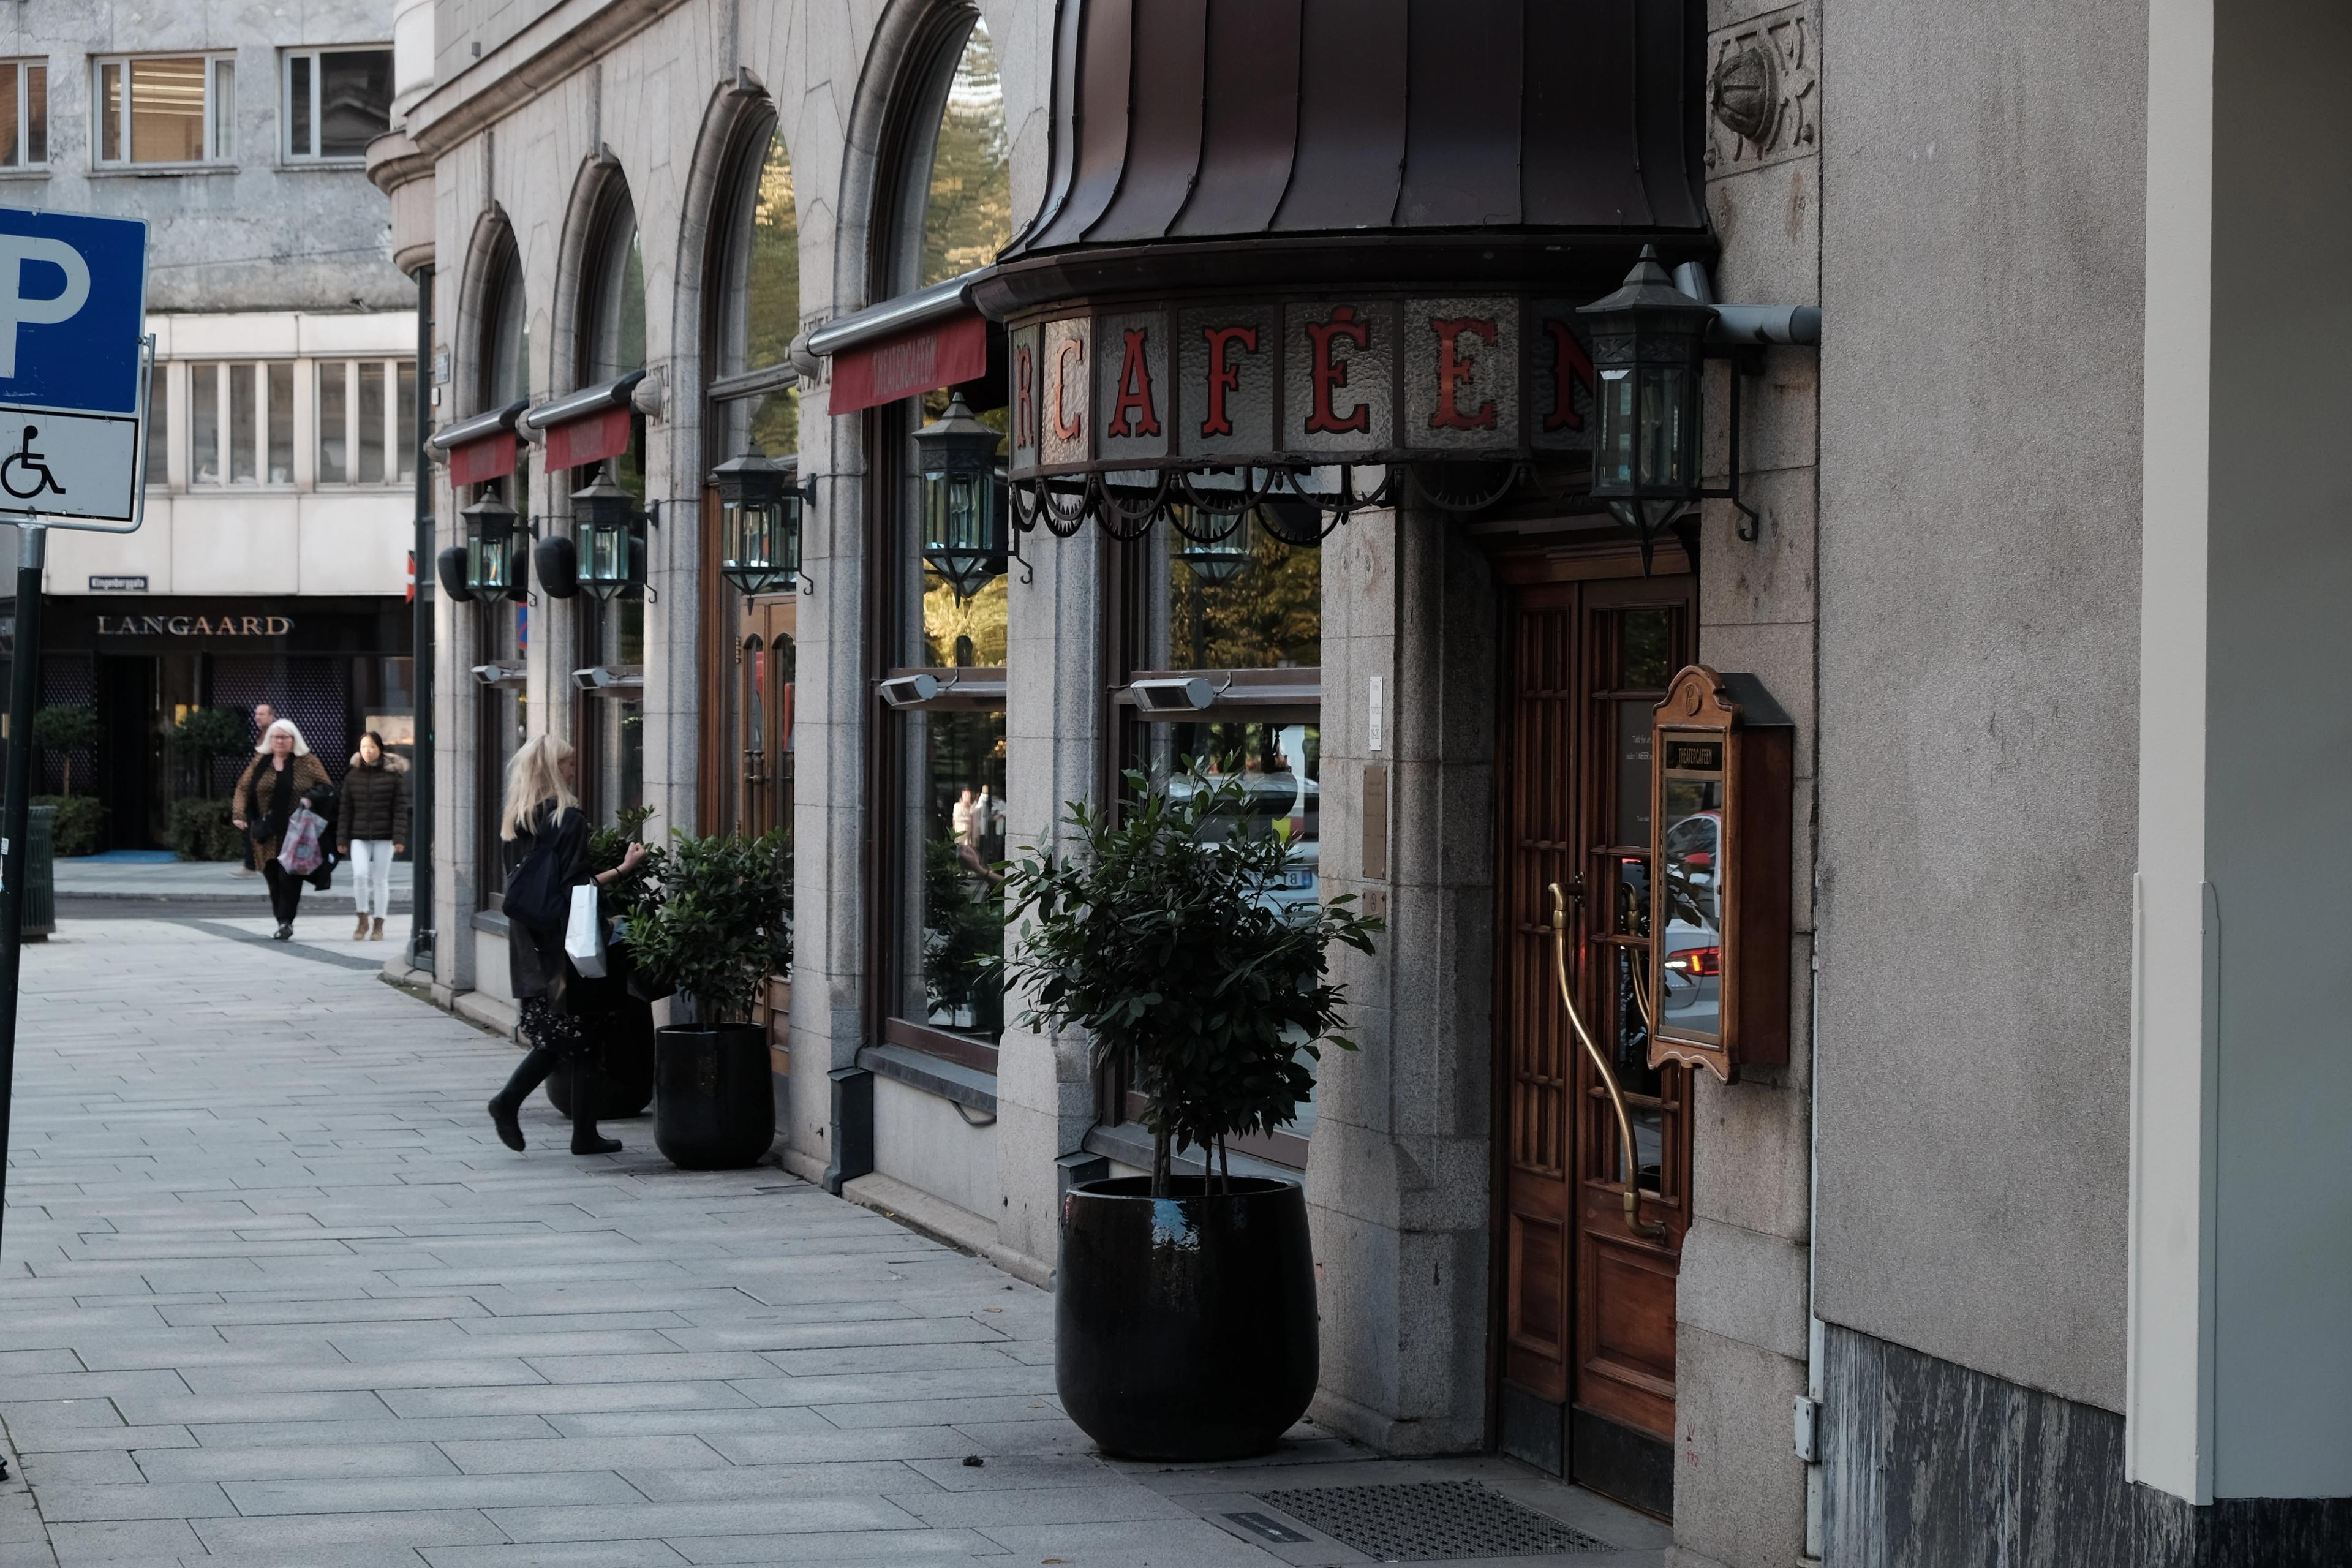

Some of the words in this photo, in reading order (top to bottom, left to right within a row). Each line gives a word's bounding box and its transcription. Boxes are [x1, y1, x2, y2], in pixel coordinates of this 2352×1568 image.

[0, 234, 91, 379] P
[96, 615, 291, 636] LANGAARD
[1679, 748, 1713, 765] THEATERCAFEEN
